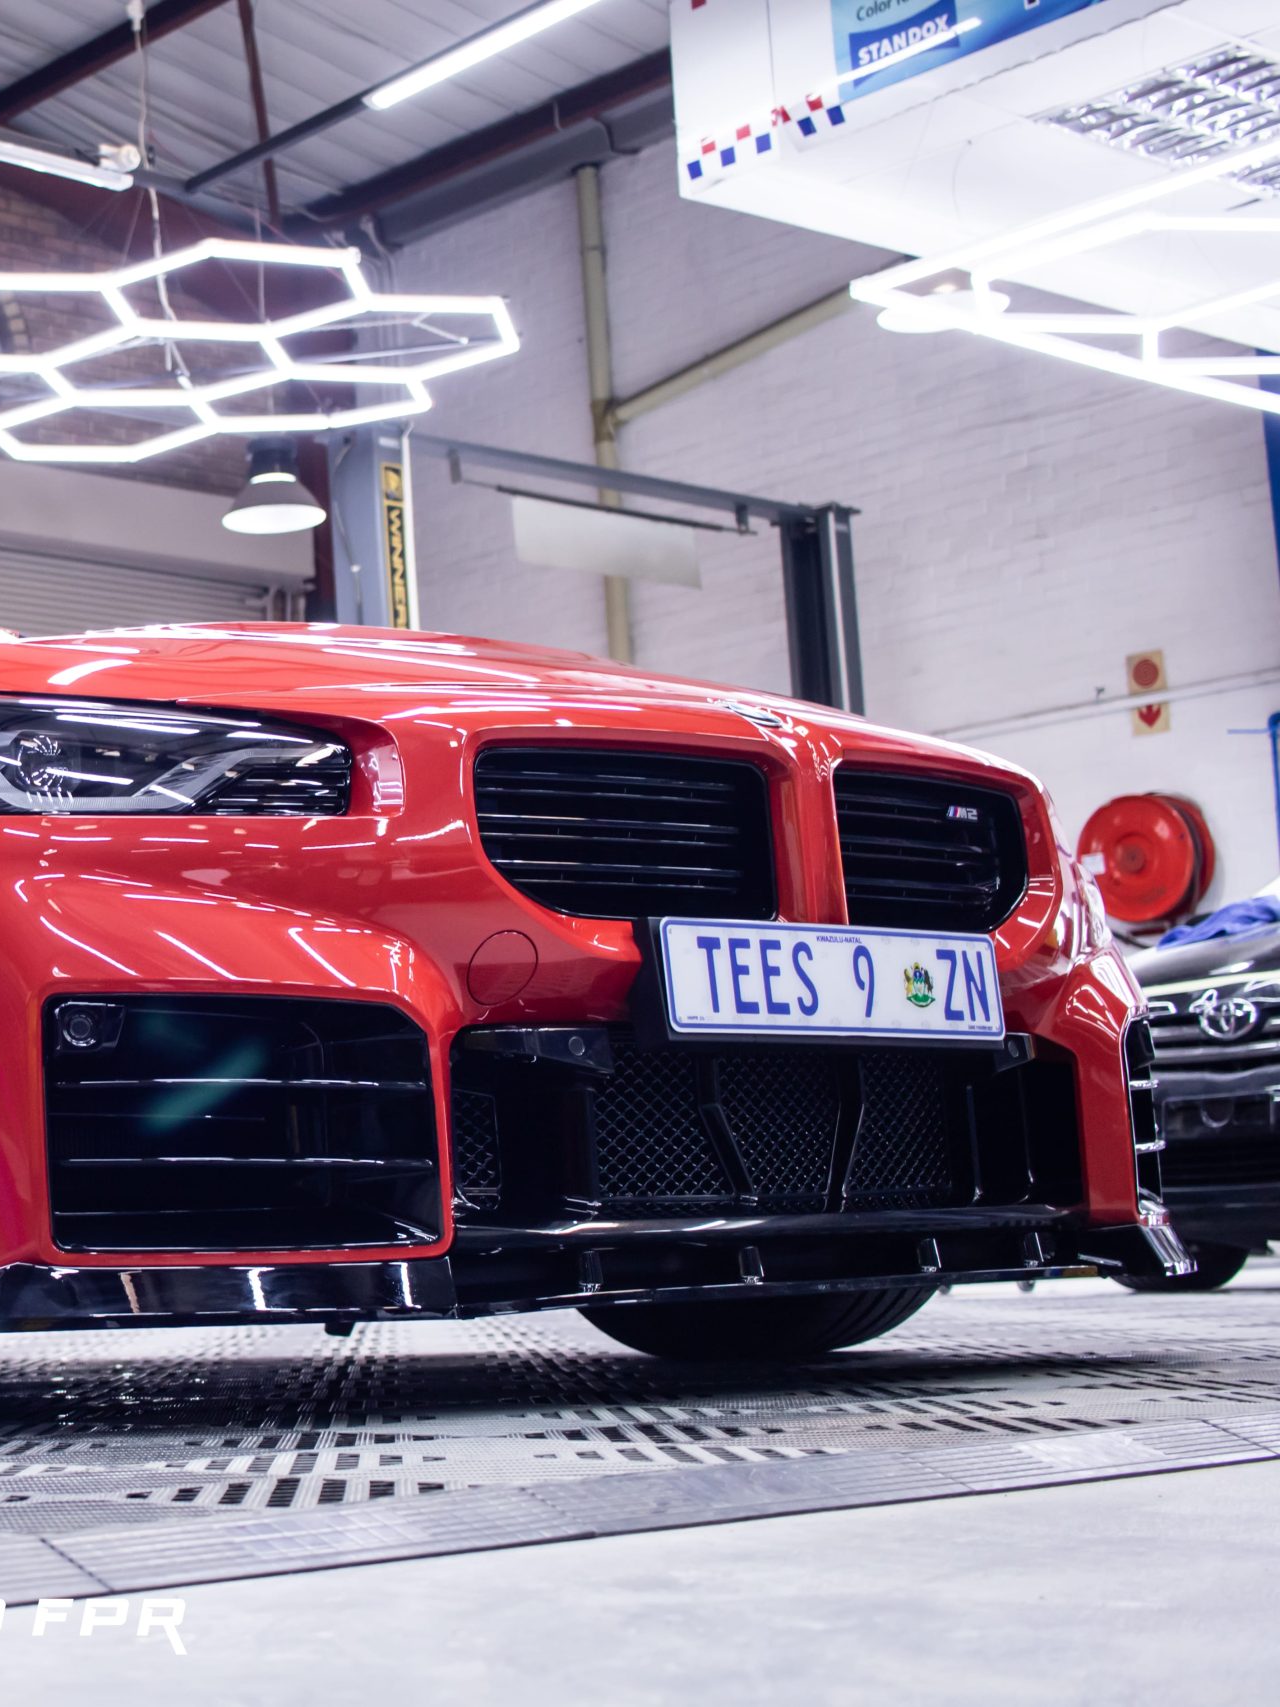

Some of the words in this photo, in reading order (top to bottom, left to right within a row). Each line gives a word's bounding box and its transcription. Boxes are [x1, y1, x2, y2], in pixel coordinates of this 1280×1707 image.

[857, 0, 893, 21] Color
[858, 14, 948, 66] STANDOX
[950, 806, 978, 820] M2
[697, 936, 819, 1016] TEES
[853, 945, 875, 1018] 9
[936, 949, 990, 1022] ZN
